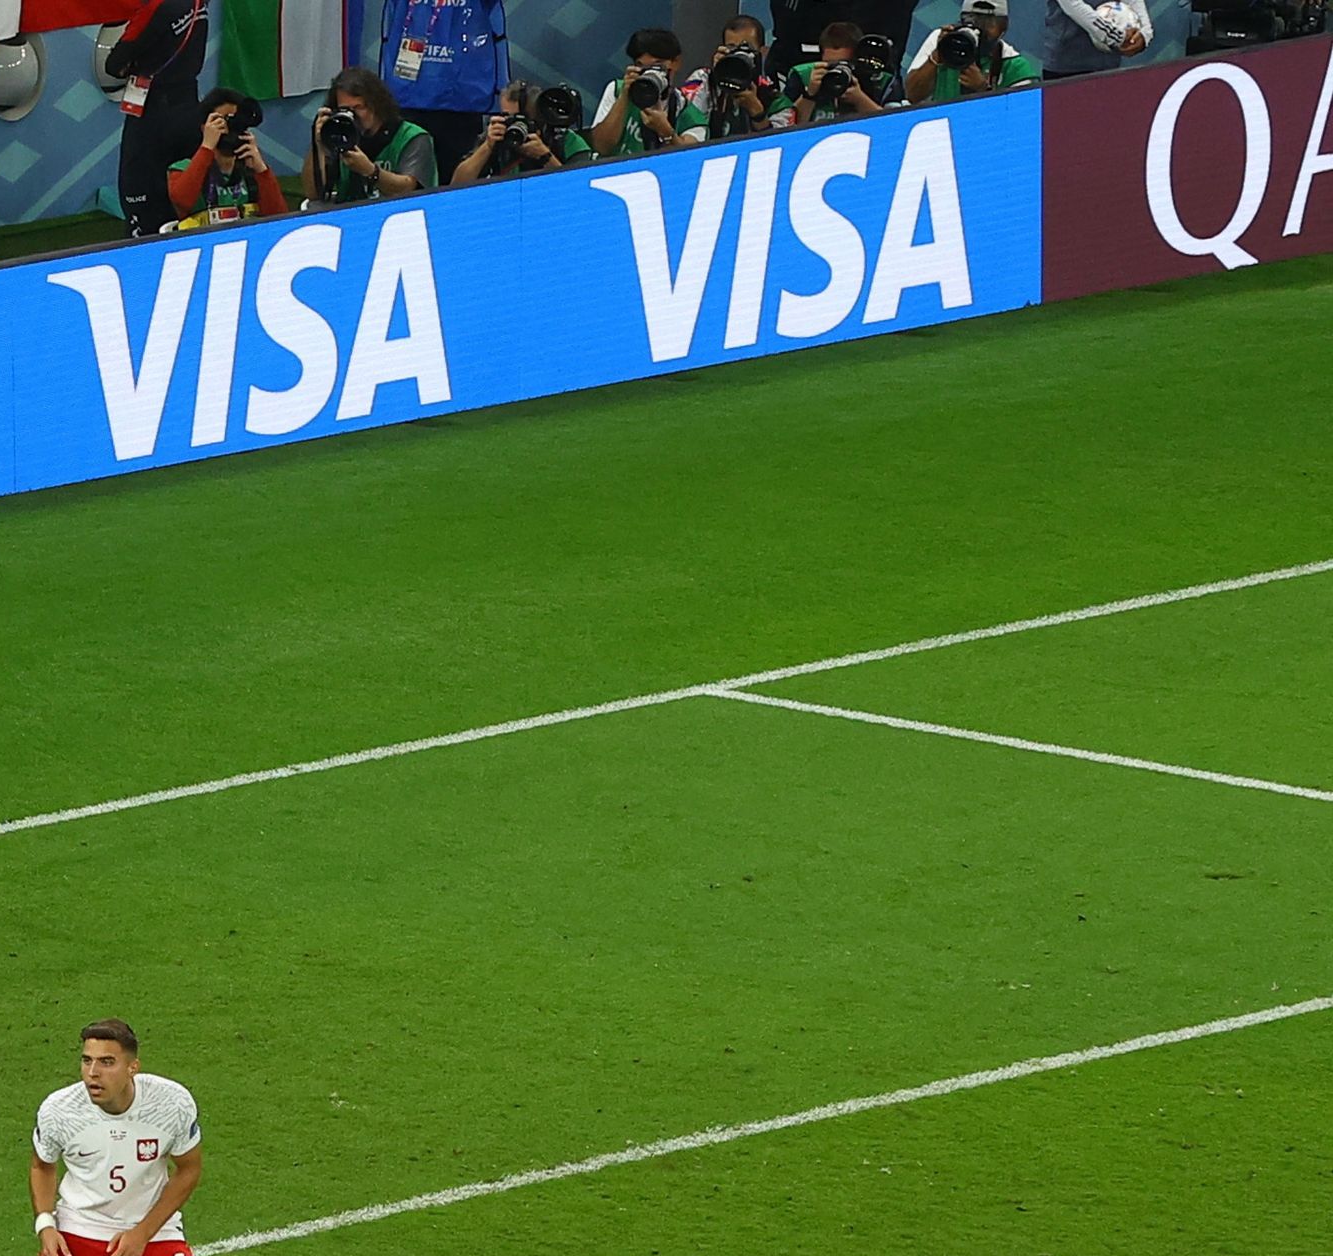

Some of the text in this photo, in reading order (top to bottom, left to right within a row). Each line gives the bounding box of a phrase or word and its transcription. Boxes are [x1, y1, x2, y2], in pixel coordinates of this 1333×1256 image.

[48, 209, 451, 460] VISA
[591, 119, 972, 362] VISA
[109, 1165, 127, 1193] 5
